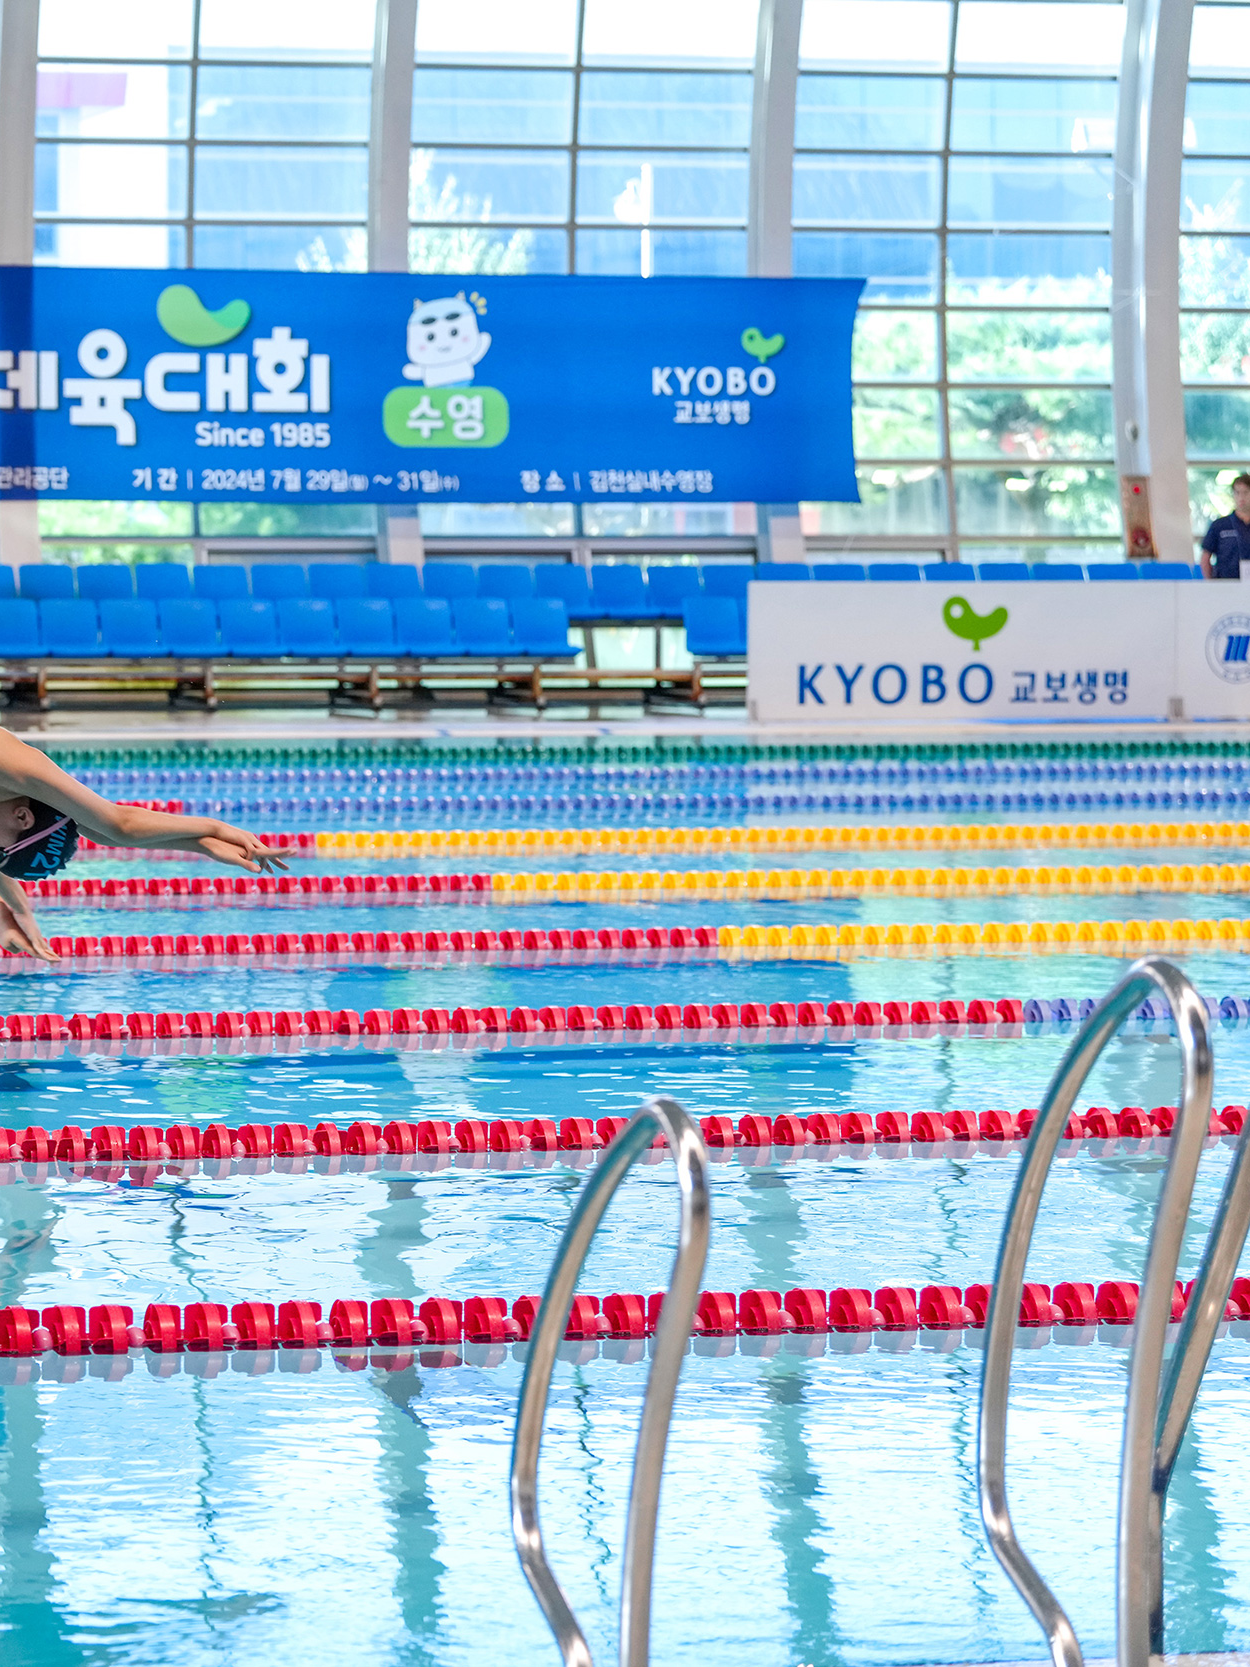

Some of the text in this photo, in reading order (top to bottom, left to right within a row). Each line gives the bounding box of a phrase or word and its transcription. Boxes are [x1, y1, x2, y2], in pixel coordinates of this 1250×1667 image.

[651, 366, 776, 397] KYOBO
[406, 395, 485, 439] 수영
[673, 400, 751, 425] 교보생명
[195, 422, 331, 447] Since 1985
[201, 468, 266, 492] 2024년
[270, 468, 301, 492] 7월
[797, 663, 994, 705] KYOBO
[1009, 669, 1130, 705] 교보생명
